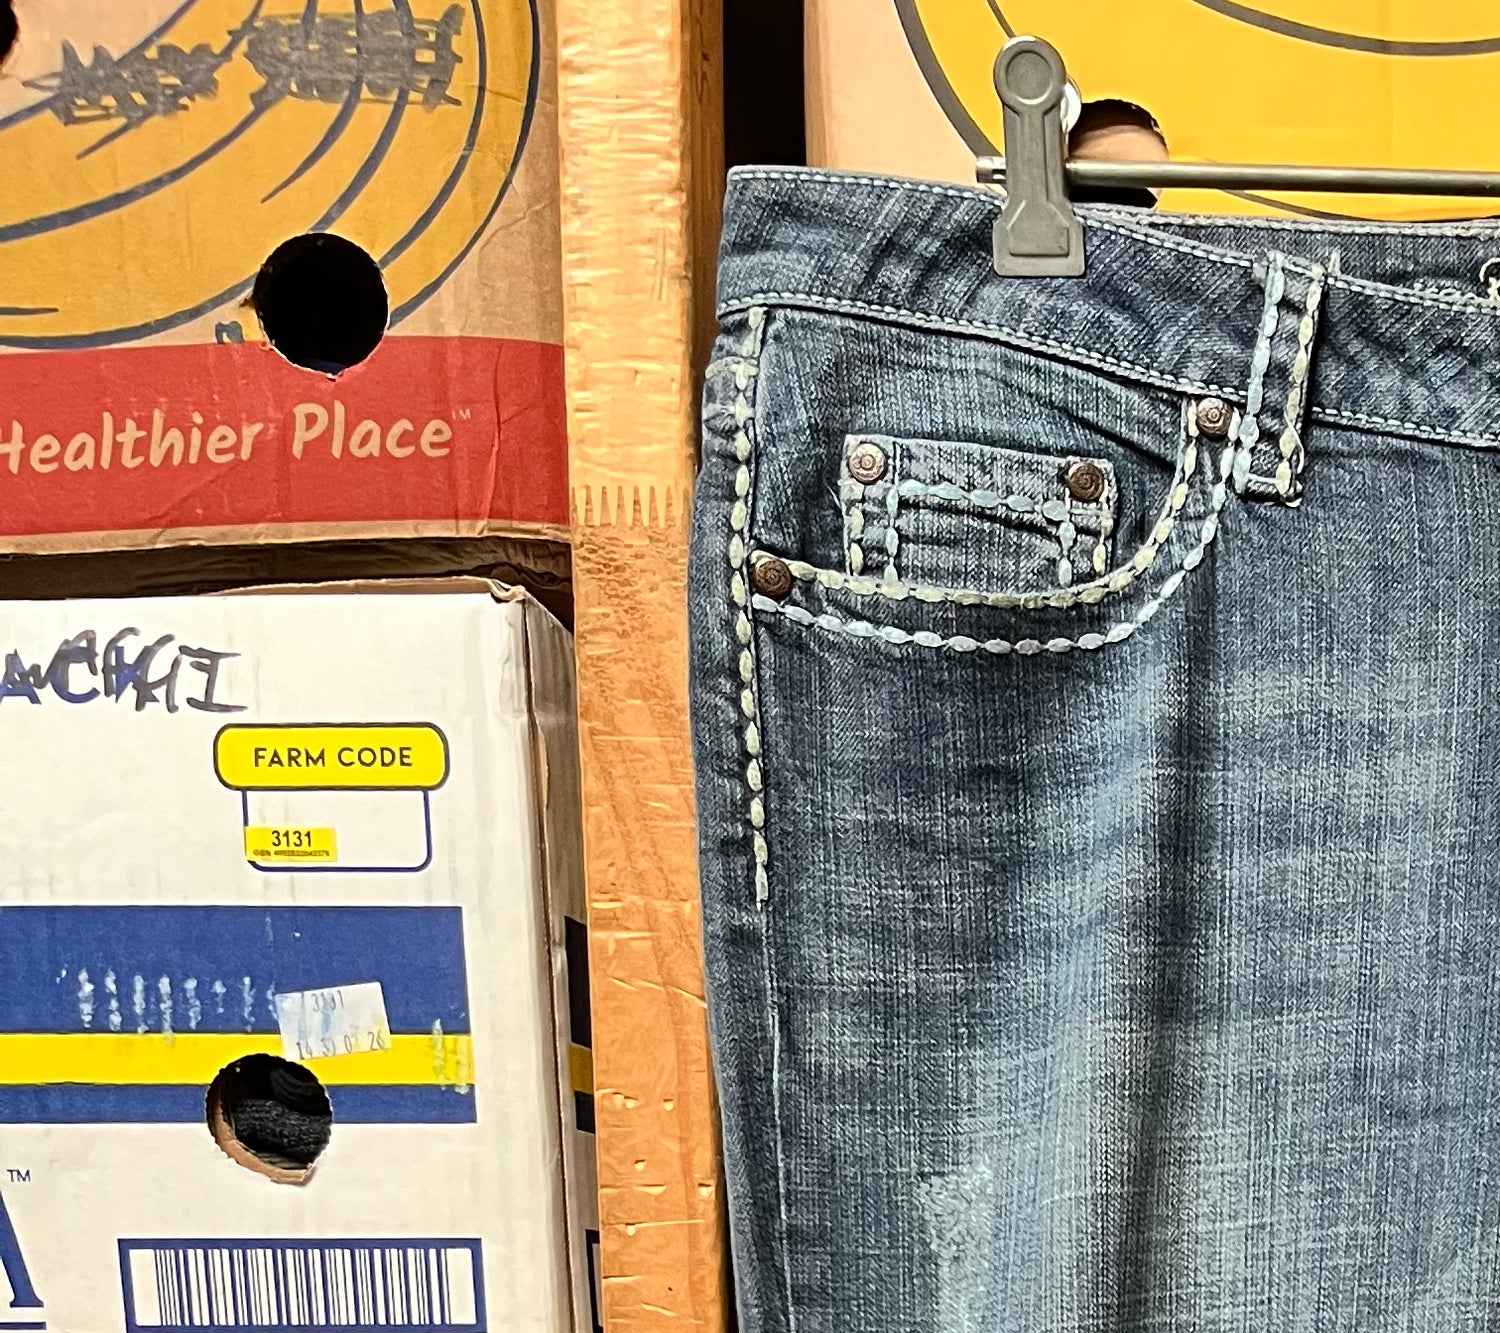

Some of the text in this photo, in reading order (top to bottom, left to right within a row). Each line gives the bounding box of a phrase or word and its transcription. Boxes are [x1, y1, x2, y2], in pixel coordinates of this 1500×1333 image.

[292, 400, 452, 460] Place
[255, 746, 413, 767] FARM CODE
[271, 830, 312, 847] 3131
